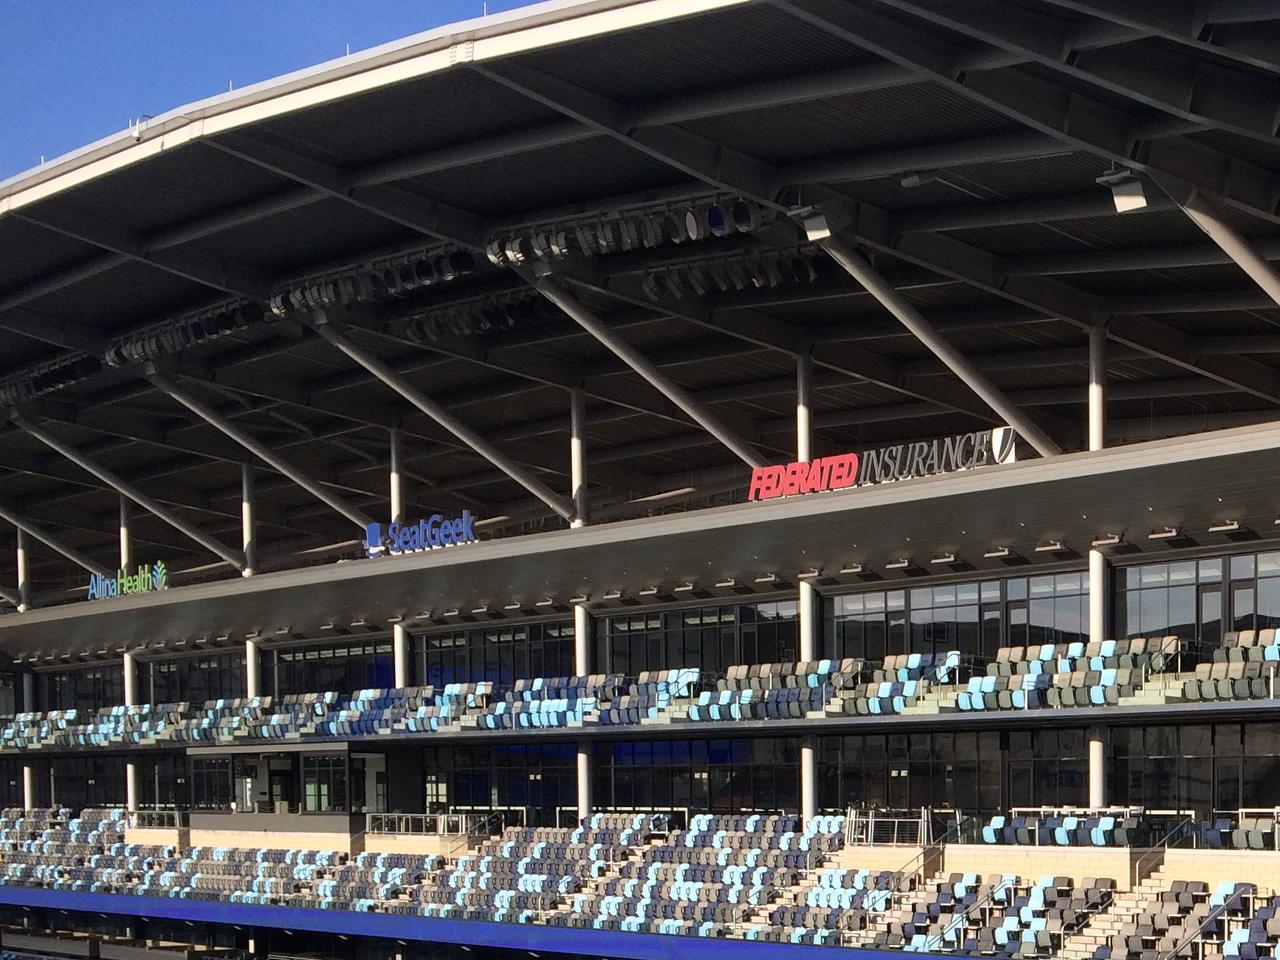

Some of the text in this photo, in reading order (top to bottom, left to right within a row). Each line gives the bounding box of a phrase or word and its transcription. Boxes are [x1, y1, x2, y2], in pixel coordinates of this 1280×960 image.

[749, 430, 990, 500] FEDERATED INSURANCE
[388, 509, 475, 553] SeatGeek
